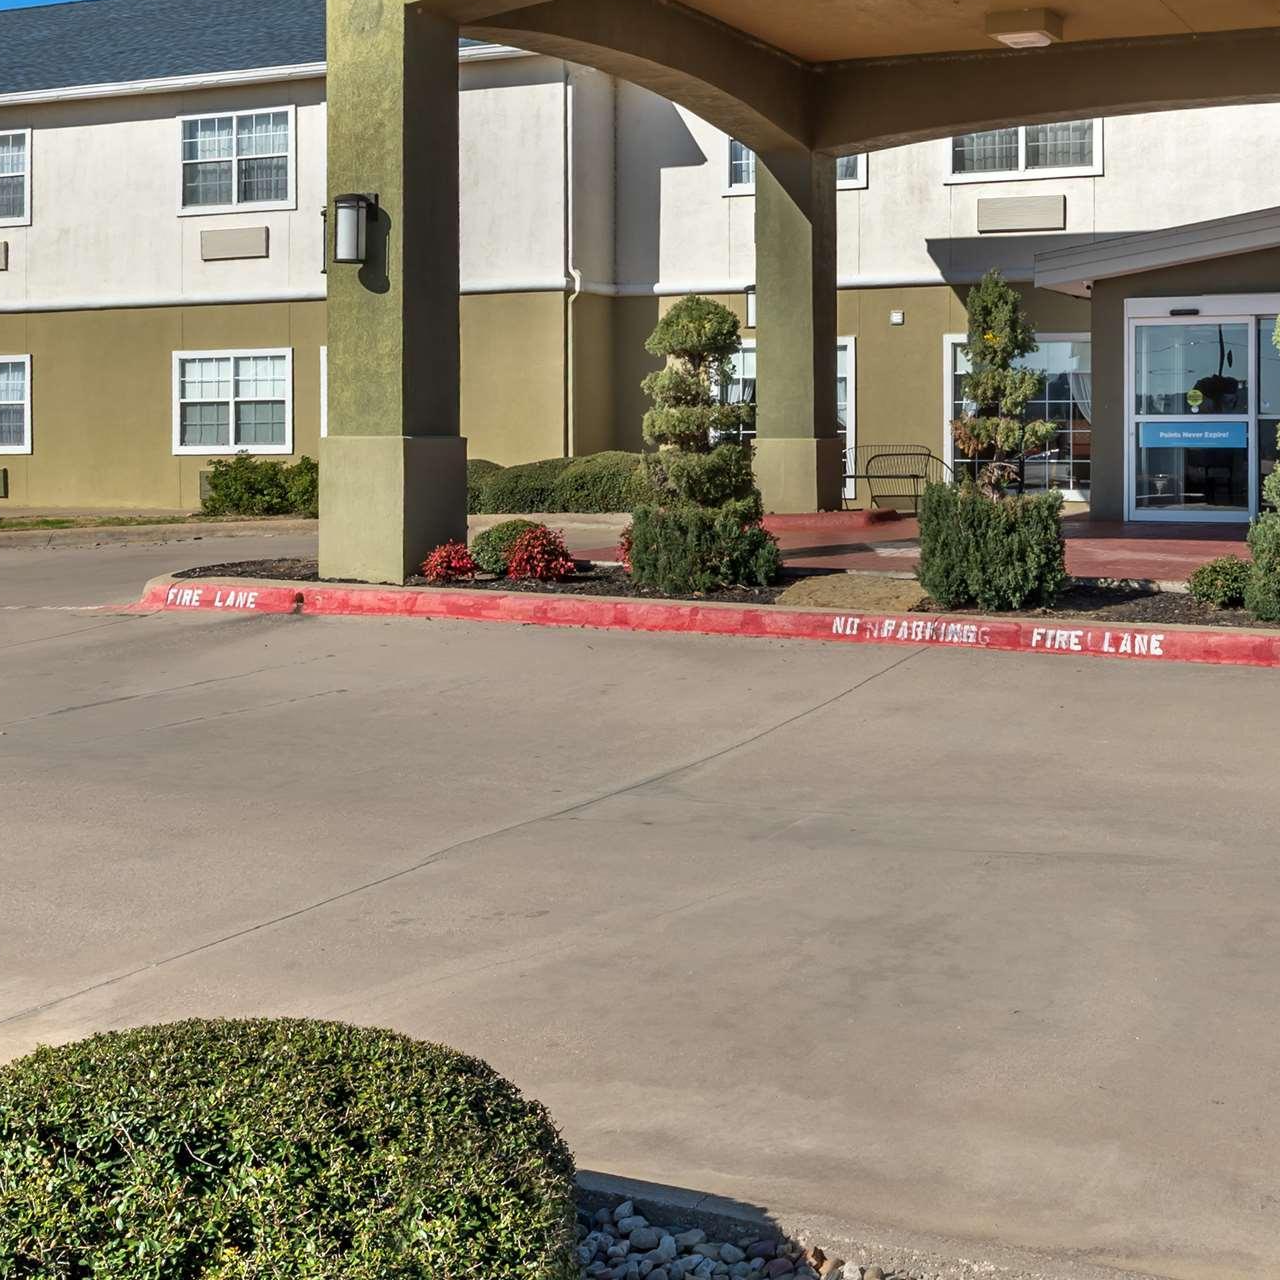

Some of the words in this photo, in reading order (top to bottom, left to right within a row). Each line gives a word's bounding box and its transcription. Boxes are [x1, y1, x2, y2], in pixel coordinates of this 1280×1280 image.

[166, 587, 204, 606] FIRE
[214, 590, 259, 609] LANE
[832, 616, 859, 635] NO
[881, 619, 978, 644] PARKING
[1031, 627, 1083, 651] FIRE
[1102, 631, 1165, 656] LANE
